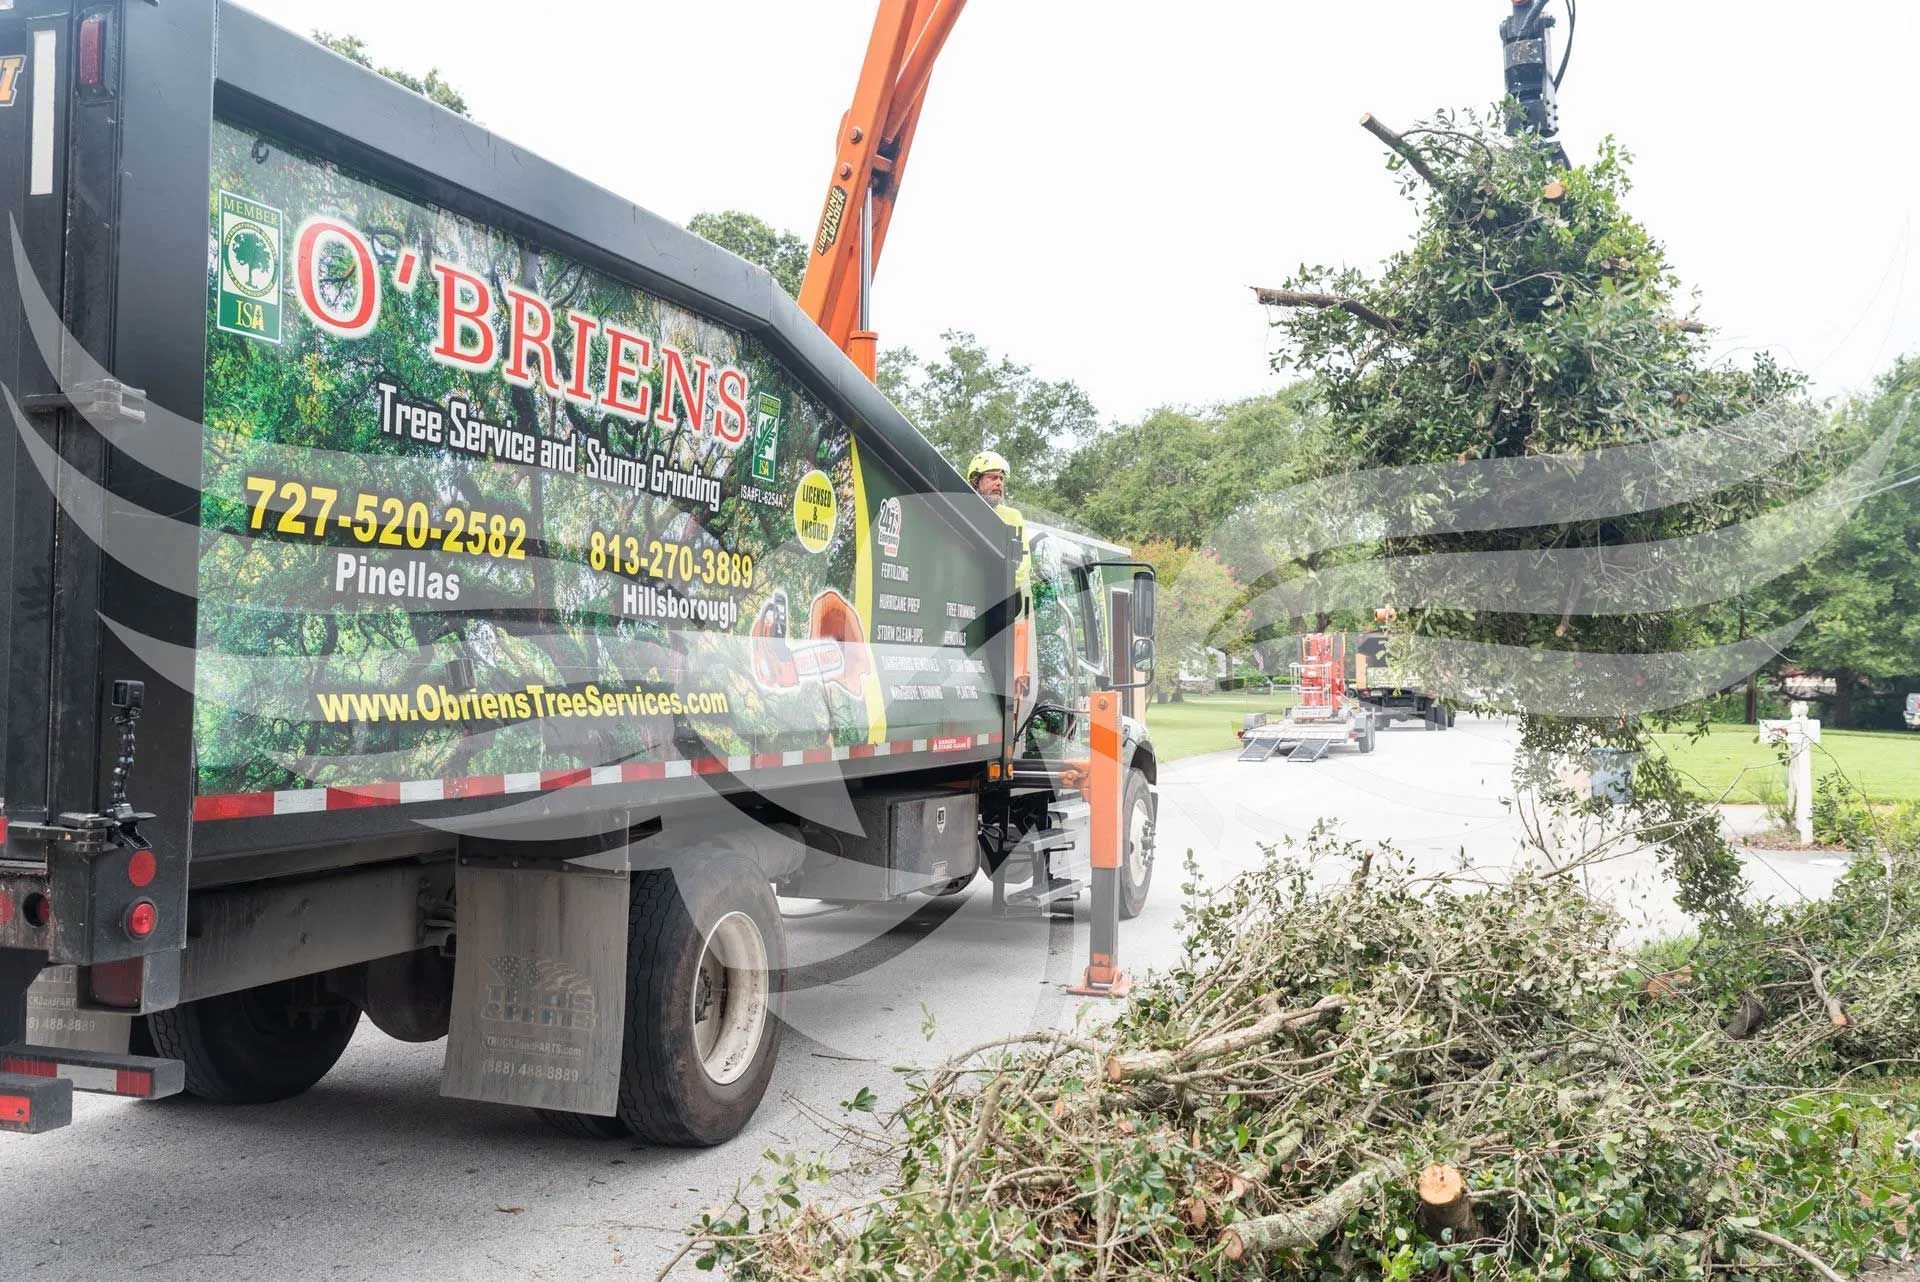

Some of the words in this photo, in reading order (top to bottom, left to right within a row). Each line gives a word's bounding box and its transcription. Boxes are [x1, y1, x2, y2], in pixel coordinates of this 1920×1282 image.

[223, 197, 278, 225] MEMBER
[815, 186, 840, 255] LIGHTNING
[826, 190, 847, 245] LOADER
[235, 299, 264, 331] ISA
[297, 222, 748, 444] O'BRIENS
[378, 383, 442, 443] Tree
[449, 402, 535, 464] Service
[540, 433, 576, 474] and
[586, 437, 647, 496] Stump
[651, 455, 721, 513] Grinding
[802, 484, 832, 508] LICENSED
[812, 506, 819, 521] &
[246, 476, 527, 561] 727-520-2582
[801, 519, 829, 541] INSURED
[335, 553, 460, 601] Pinellas
[590, 531, 753, 589] 813-270-3889
[881, 562, 909, 582] FERTILIZING
[622, 583, 738, 630] Hillsborough
[879, 593, 907, 612] HURRICANE
[907, 597, 920, 613] PREP
[945, 602, 957, 617] TREE
[877, 624, 895, 641] STORM
[896, 626, 923, 643] CLEAN-UPS
[317, 684, 729, 723] www.ObriensTreeServices.com
